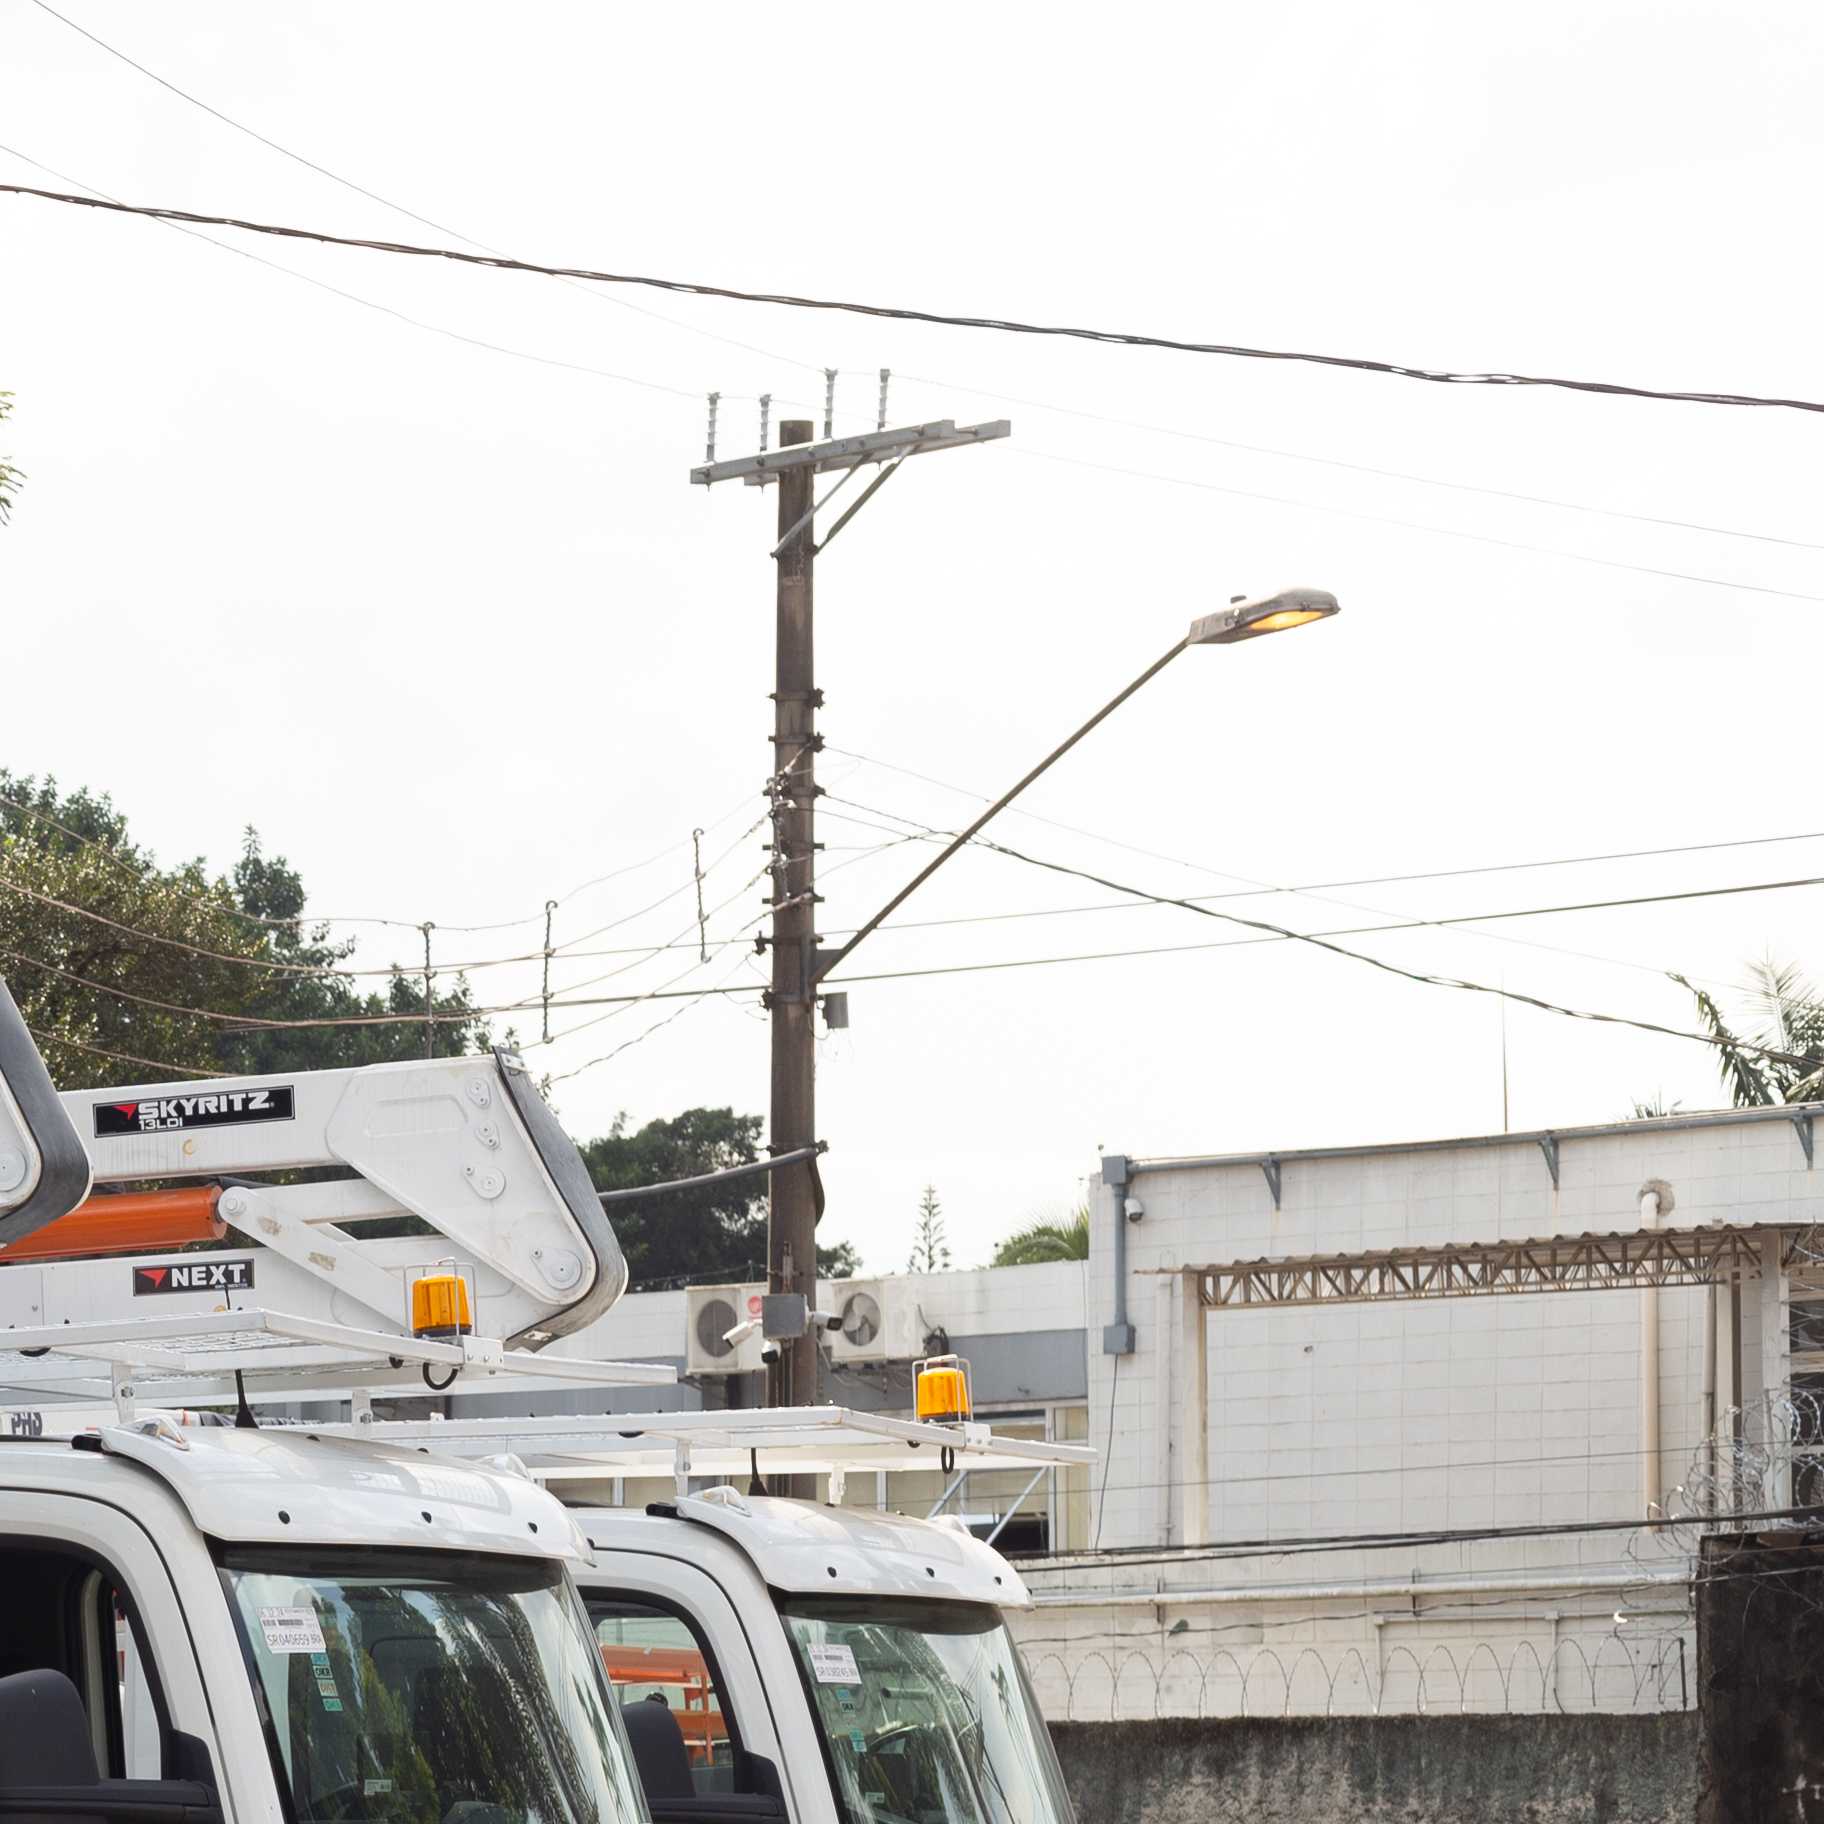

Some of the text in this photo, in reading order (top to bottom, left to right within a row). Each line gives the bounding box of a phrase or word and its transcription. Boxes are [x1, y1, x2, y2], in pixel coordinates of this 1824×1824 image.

[138, 1091, 270, 1120] SKYRITZ
[139, 1117, 183, 1131] 13LDI
[171, 1263, 245, 1288] NEXT
